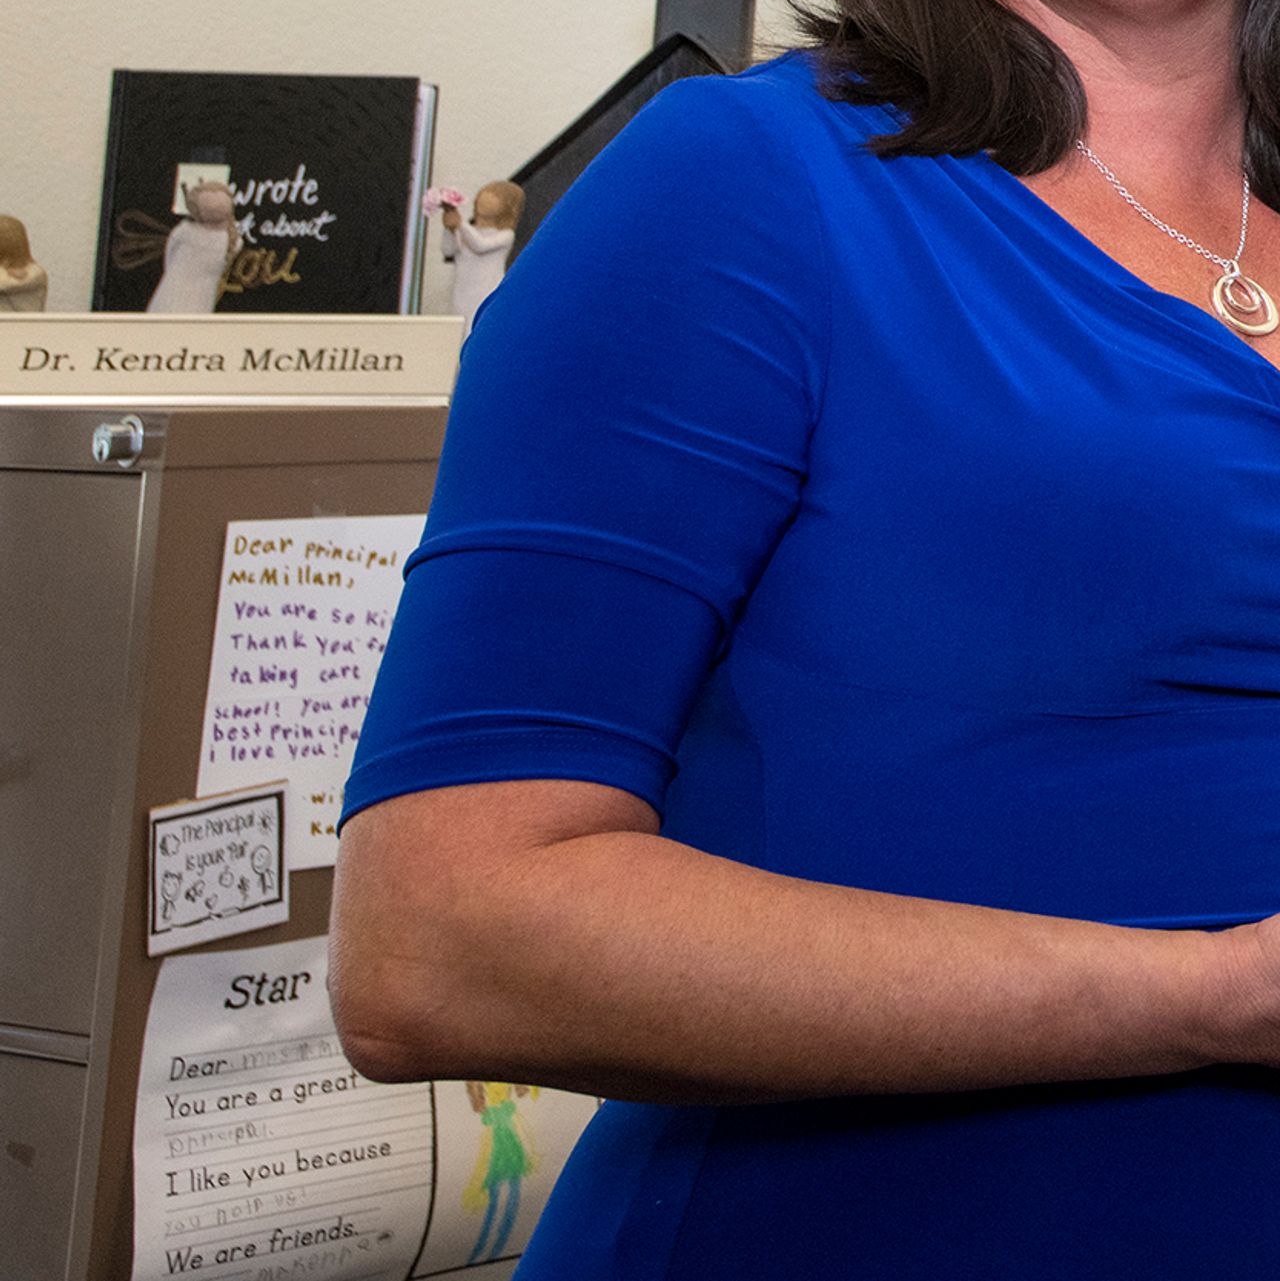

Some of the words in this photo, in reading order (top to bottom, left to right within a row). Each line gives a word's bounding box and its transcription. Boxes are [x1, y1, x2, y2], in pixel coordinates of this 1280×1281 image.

[229, 163, 320, 207] wrote
[260, 210, 338, 243] about
[19, 346, 77, 372] Dr.
[92, 346, 226, 372] Kendra
[239, 347, 405, 372] McMillan
[233, 535, 294, 556] Dear
[304, 539, 397, 569] principal
[281, 602, 318, 621] are
[331, 607, 355, 625] so
[230, 629, 308, 651] Thank
[366, 637, 386, 654] fo
[230, 664, 298, 689] taking
[319, 664, 361, 683] care
[213, 722, 262, 742] best
[270, 719, 360, 746] principa
[230, 745, 275, 761] love
[224, 972, 311, 1009] Star
[169, 1056, 228, 1082] Dear
[165, 1093, 206, 1119] You
[217, 1091, 258, 1111] are
[269, 1087, 283, 1102] a
[293, 1071, 359, 1104] great
[165, 1171, 179, 1197] I
[190, 1167, 231, 1193] like
[242, 1160, 285, 1187] you
[295, 1141, 392, 1172] because
[165, 1246, 204, 1274] We
[215, 1242, 257, 1265] are
[269, 1216, 359, 1253] friends.
